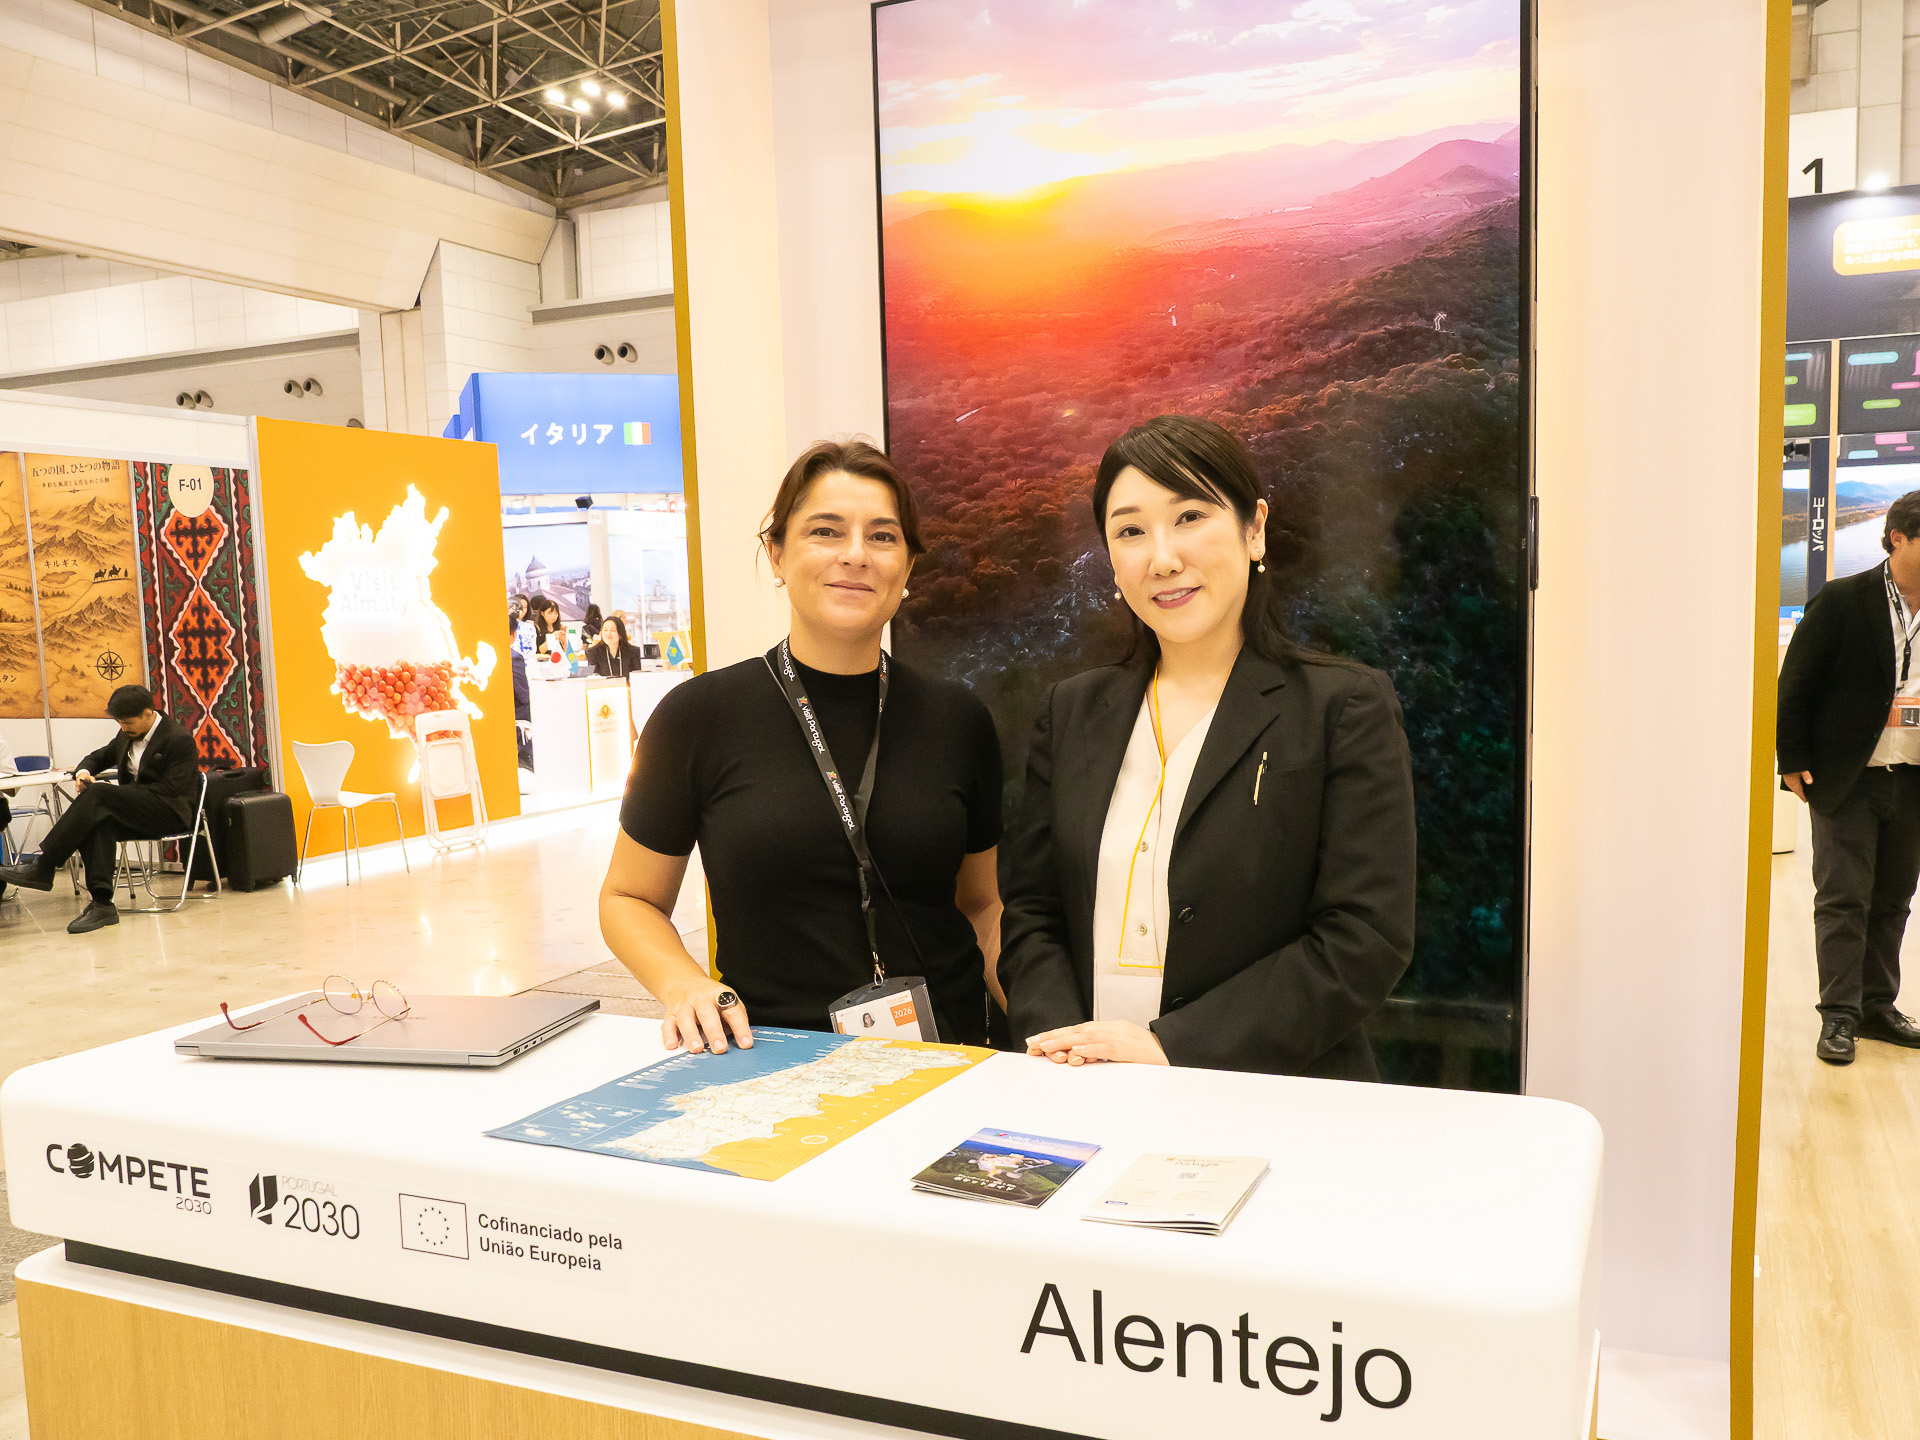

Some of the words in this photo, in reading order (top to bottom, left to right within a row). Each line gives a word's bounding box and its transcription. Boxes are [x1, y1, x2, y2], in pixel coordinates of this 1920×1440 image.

[1802, 157, 1823, 193] 1
[520, 422, 614, 446] イタリア
[179, 477, 202, 491] F-01
[1812, 497, 1825, 552] ヨーロッパ
[44, 559, 79, 568] キルギス
[350, 569, 399, 592] Visit
[339, 592, 409, 617] Almaty
[0, 674, 17, 683] タン
[894, 1006, 913, 1020] 2026
[46, 1143, 210, 1198] COMPETE
[281, 1175, 338, 1197] PORTUGAL
[176, 1197, 212, 1215] 2030
[283, 1195, 360, 1240] 2030
[478, 1213, 582, 1244] Cofinanciado
[588, 1233, 623, 1250] pela
[479, 1236, 524, 1258] União
[530, 1245, 602, 1271] Europeia
[1020, 1283, 1412, 1422] Alentejo
